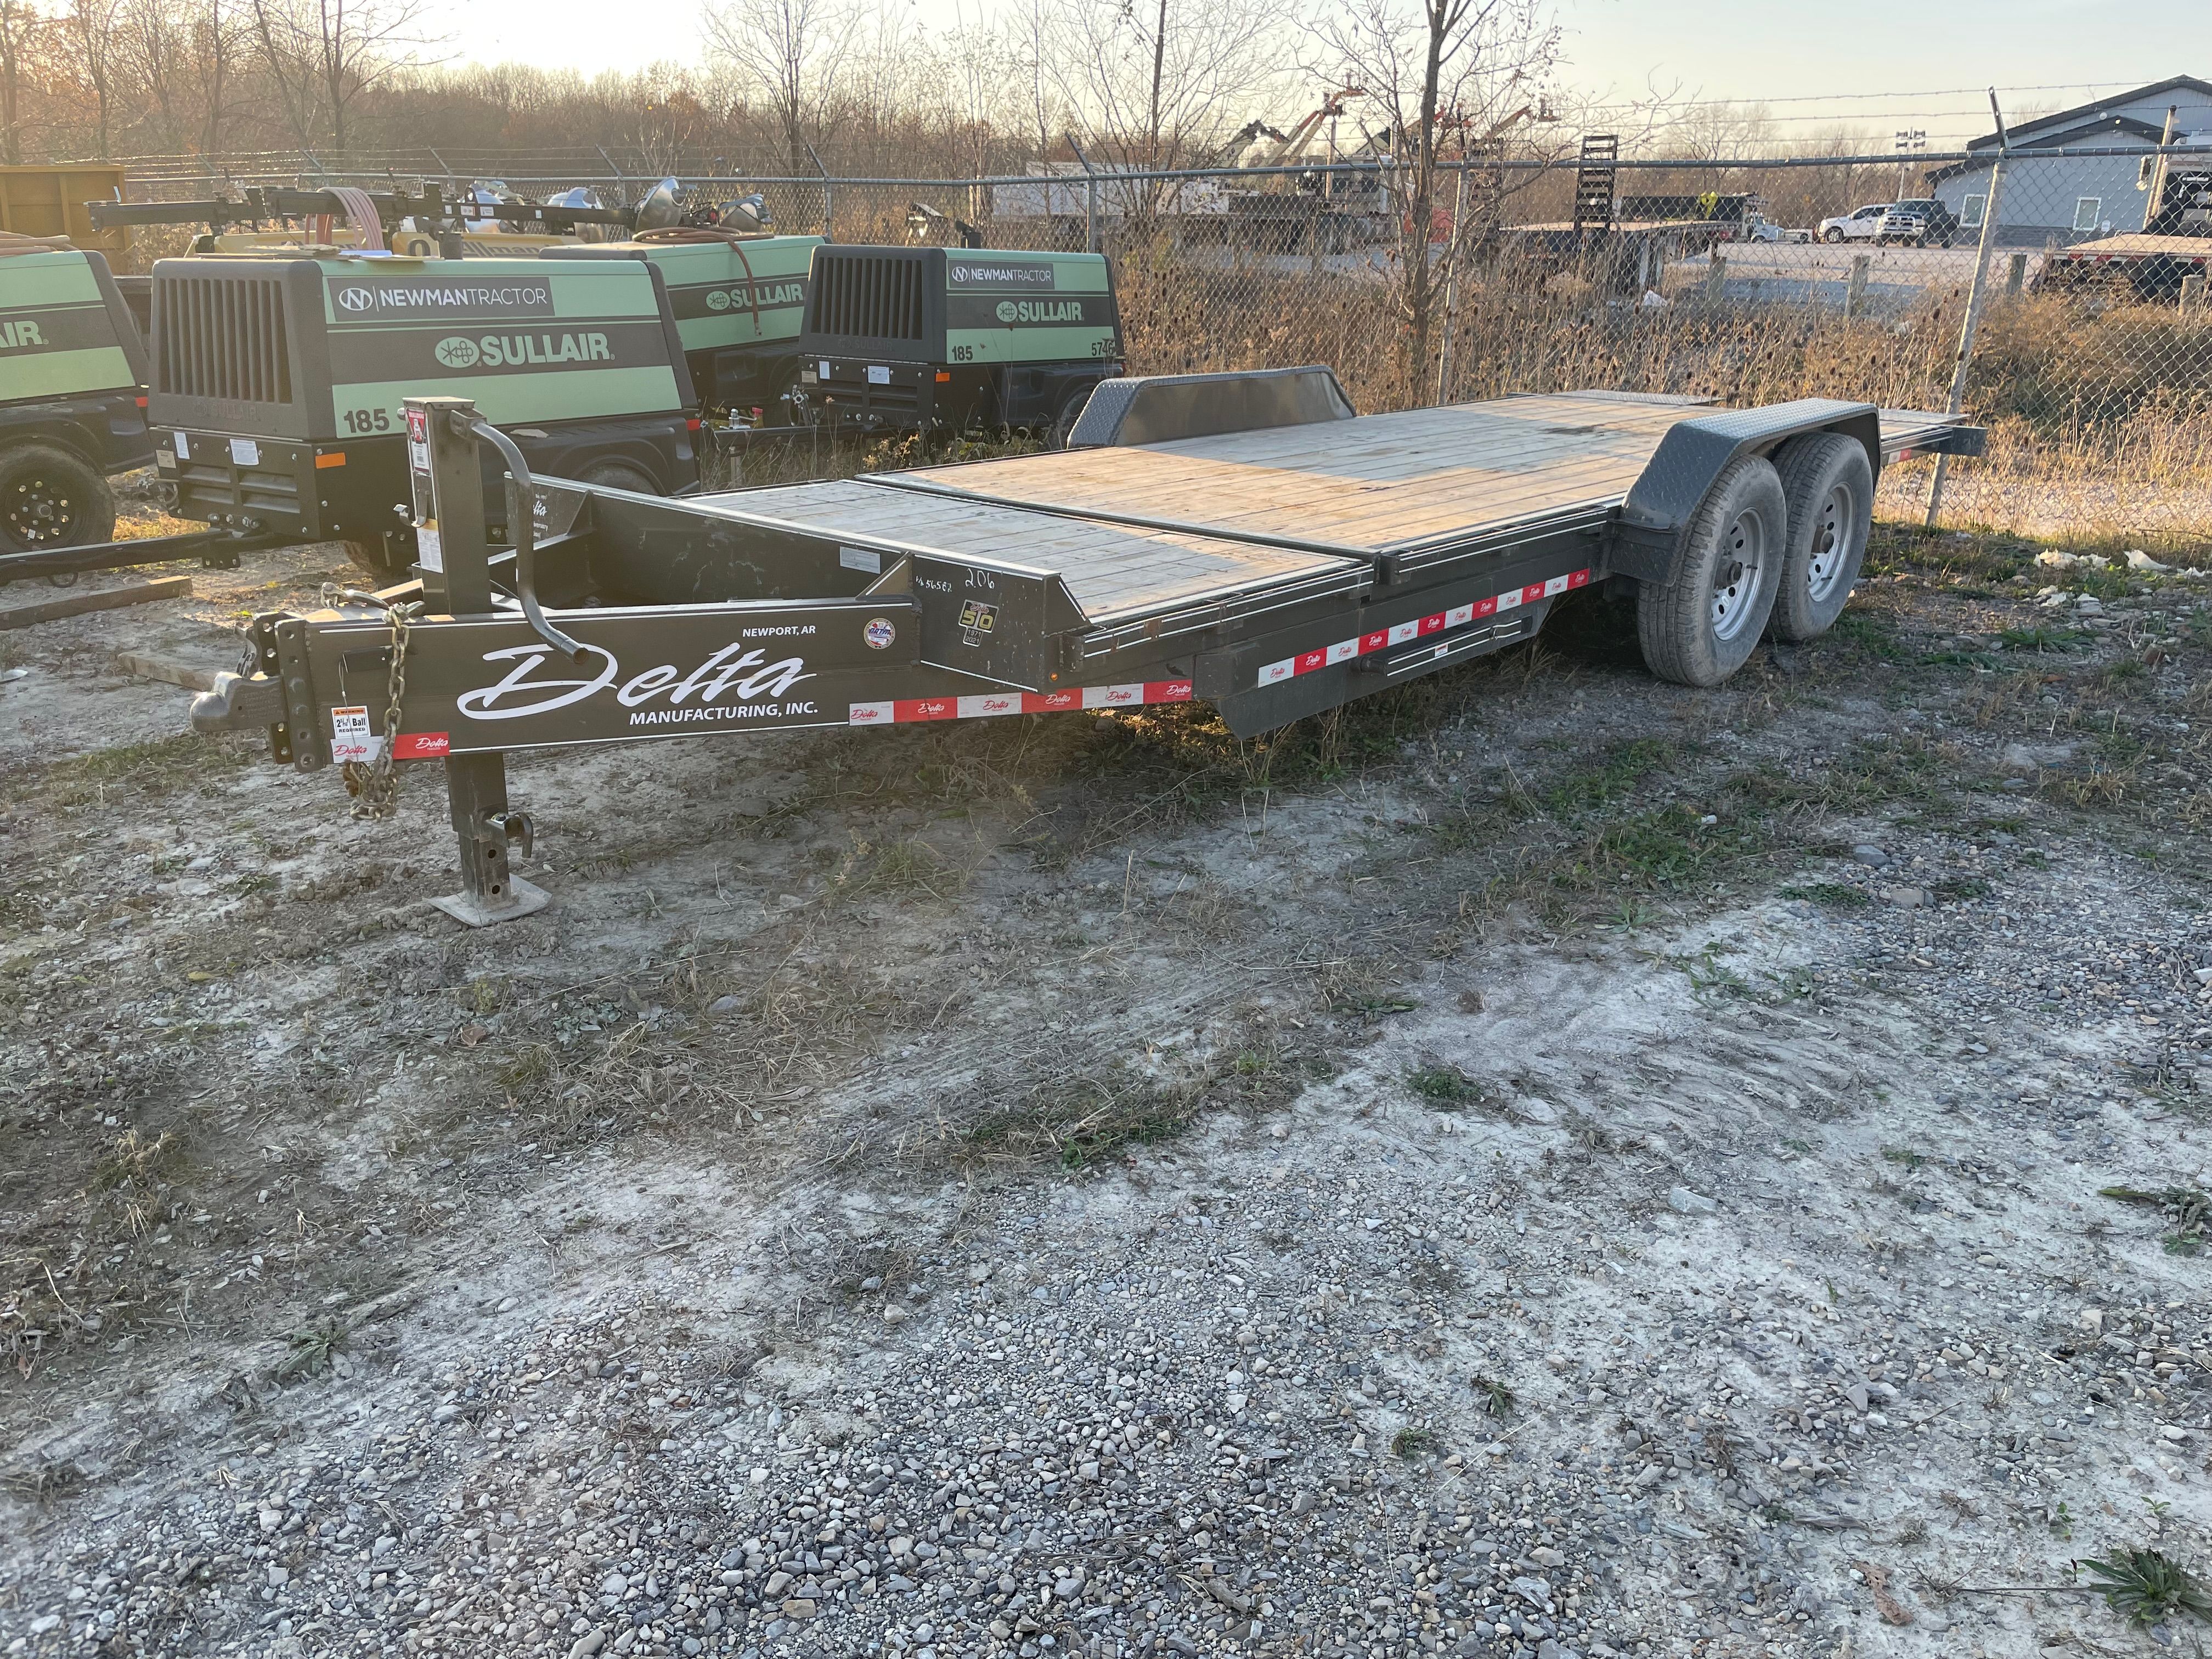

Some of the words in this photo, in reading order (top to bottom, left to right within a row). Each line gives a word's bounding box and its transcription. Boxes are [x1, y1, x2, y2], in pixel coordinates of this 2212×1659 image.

[730, 284, 803, 308] SULLAIR
[1018, 301, 1082, 322] SULLAIR
[480, 332, 610, 366] SULLAIR
[951, 345, 973, 361] 185
[343, 408, 390, 433] 185
[742, 627, 799, 638] NEWPORT,
[801, 625, 816, 634] AR
[968, 629, 981, 637] 1971
[965, 636, 980, 644] 2021
[456, 642, 817, 720] Delta
[1107, 691, 1131, 701] Delta
[983, 700, 1009, 710] Delta
[629, 703, 782, 725] MANUFACTURING,
[786, 702, 818, 715] INC.
[850, 709, 878, 719] Delta
[352, 718, 366, 726] Ball
[415, 737, 449, 749] Delta
[334, 745, 367, 756] Delta
